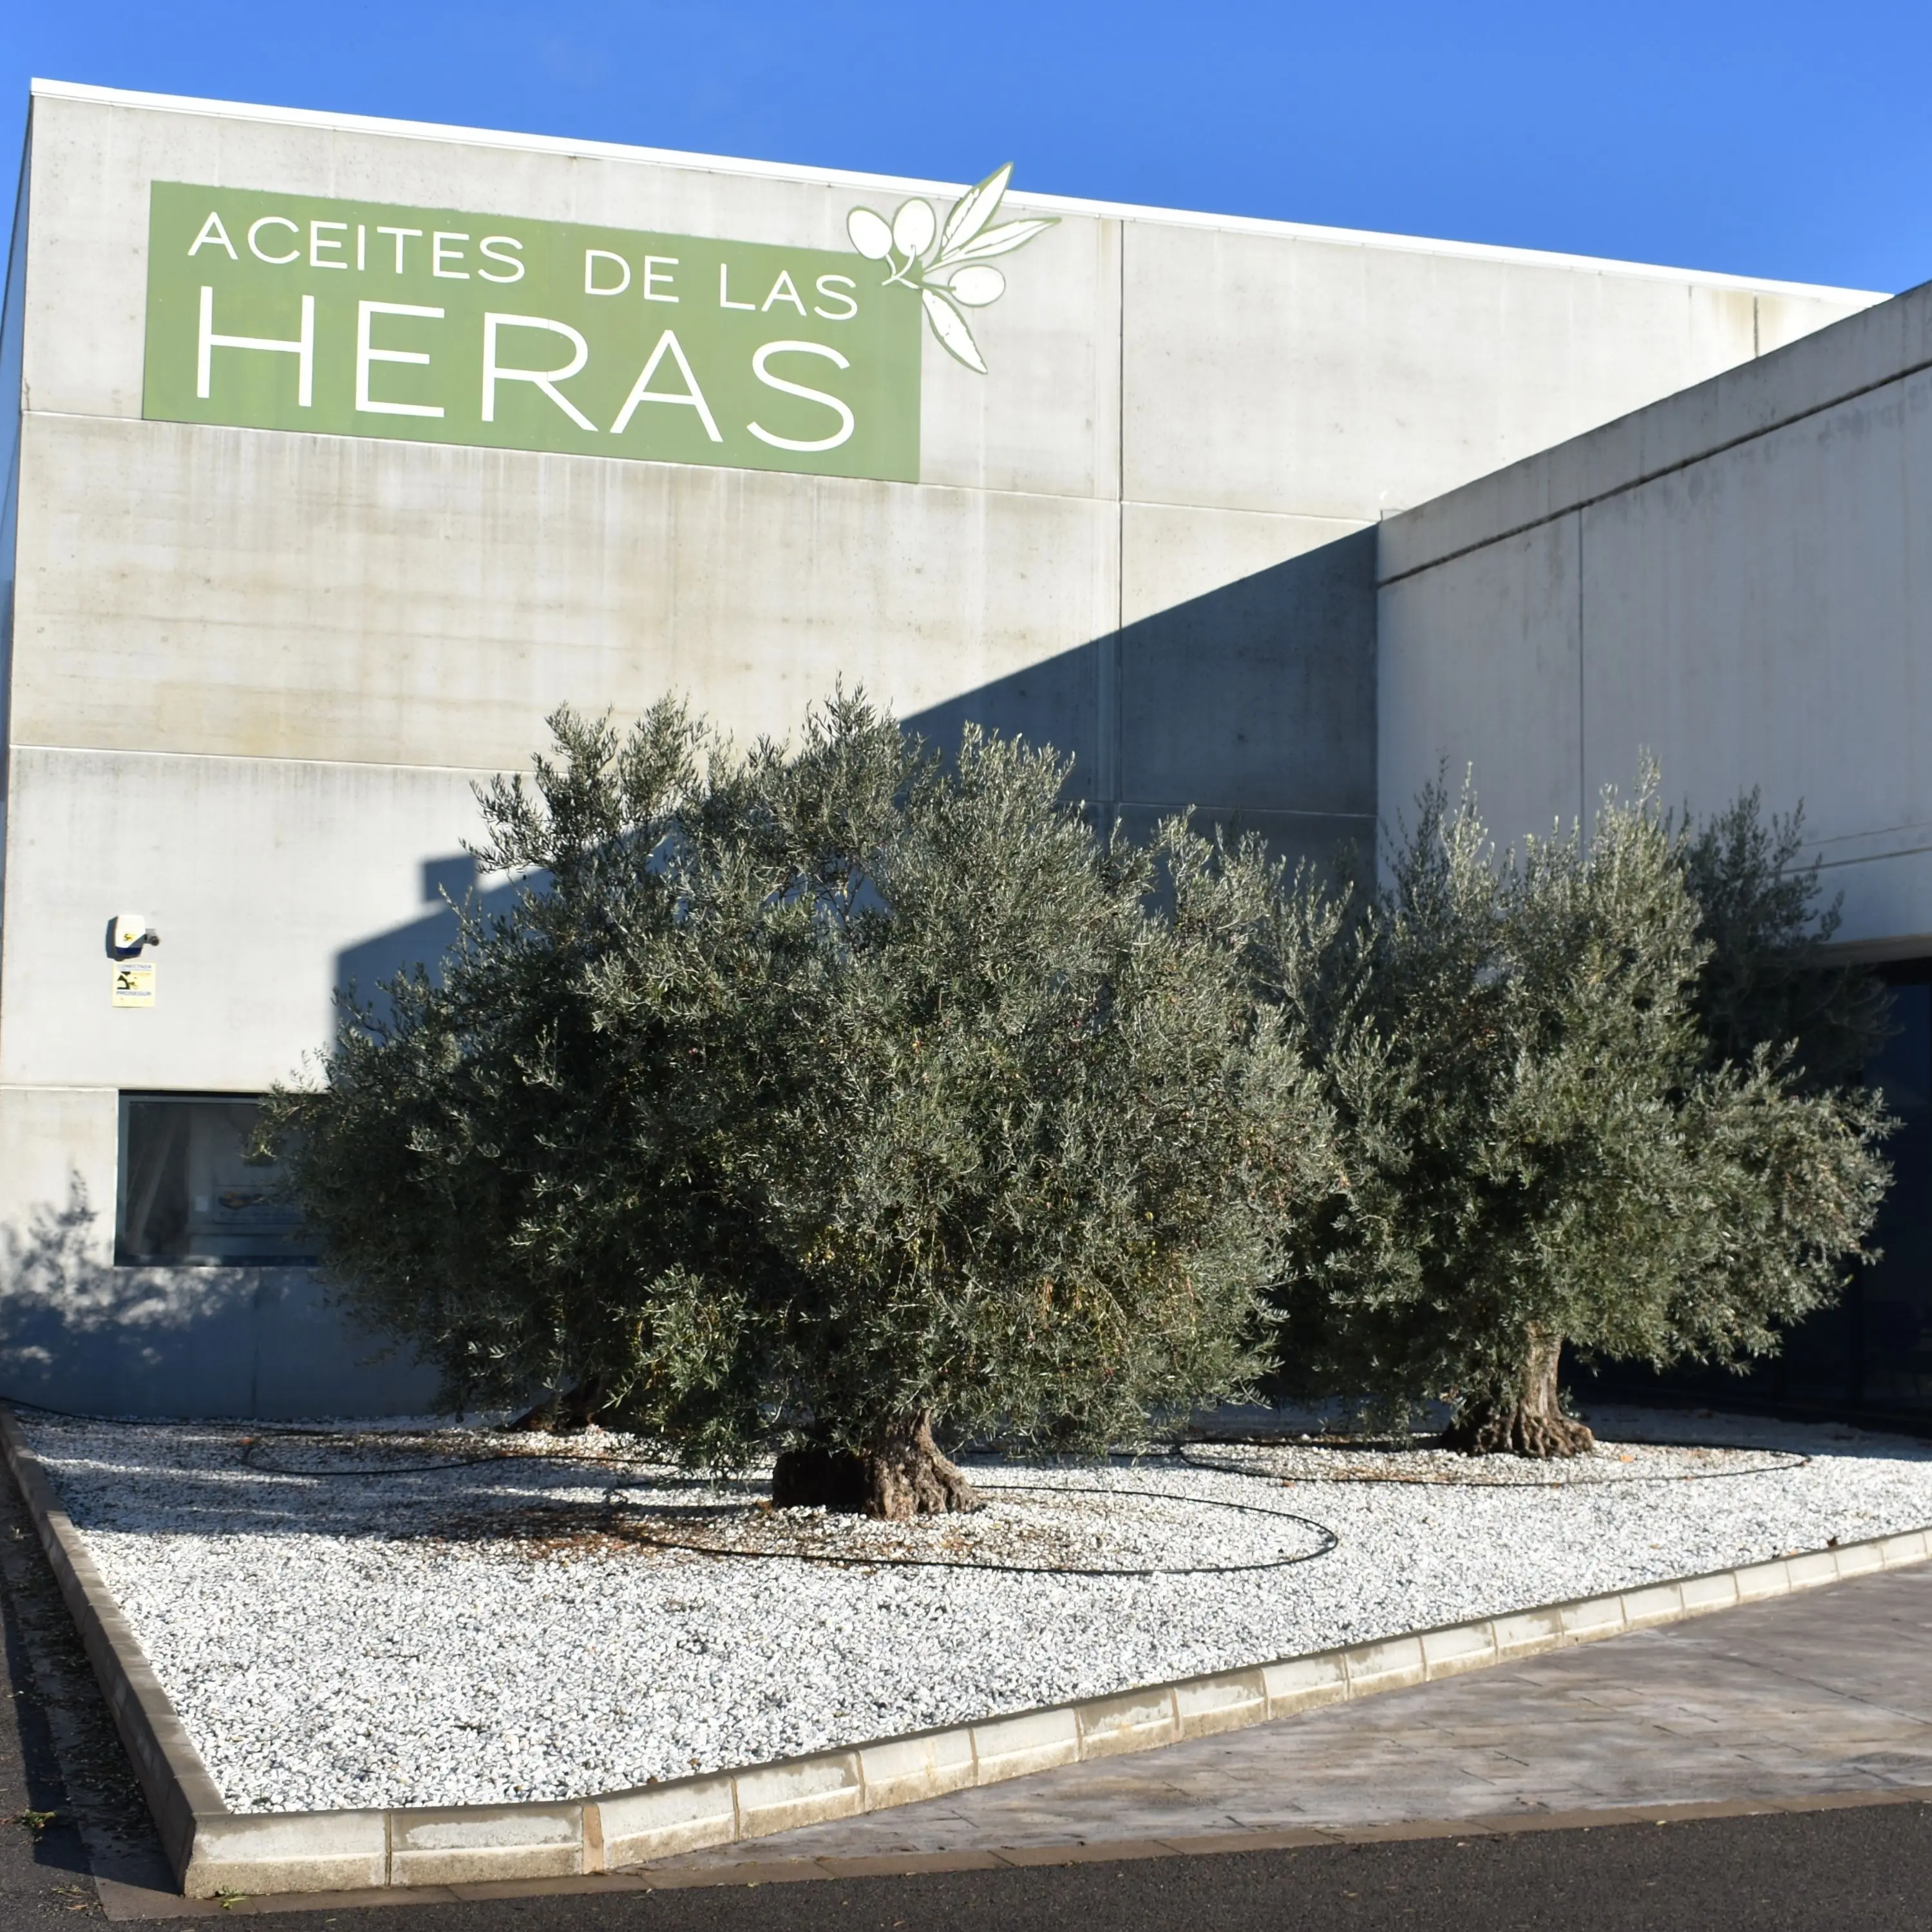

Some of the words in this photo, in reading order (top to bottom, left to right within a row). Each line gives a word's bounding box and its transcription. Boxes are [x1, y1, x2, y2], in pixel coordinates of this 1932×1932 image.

[187, 211, 526, 284] ACEITES
[584, 249, 680, 303] DE
[719, 262, 858, 321] LAS
[196, 285, 855, 453] HERAS
